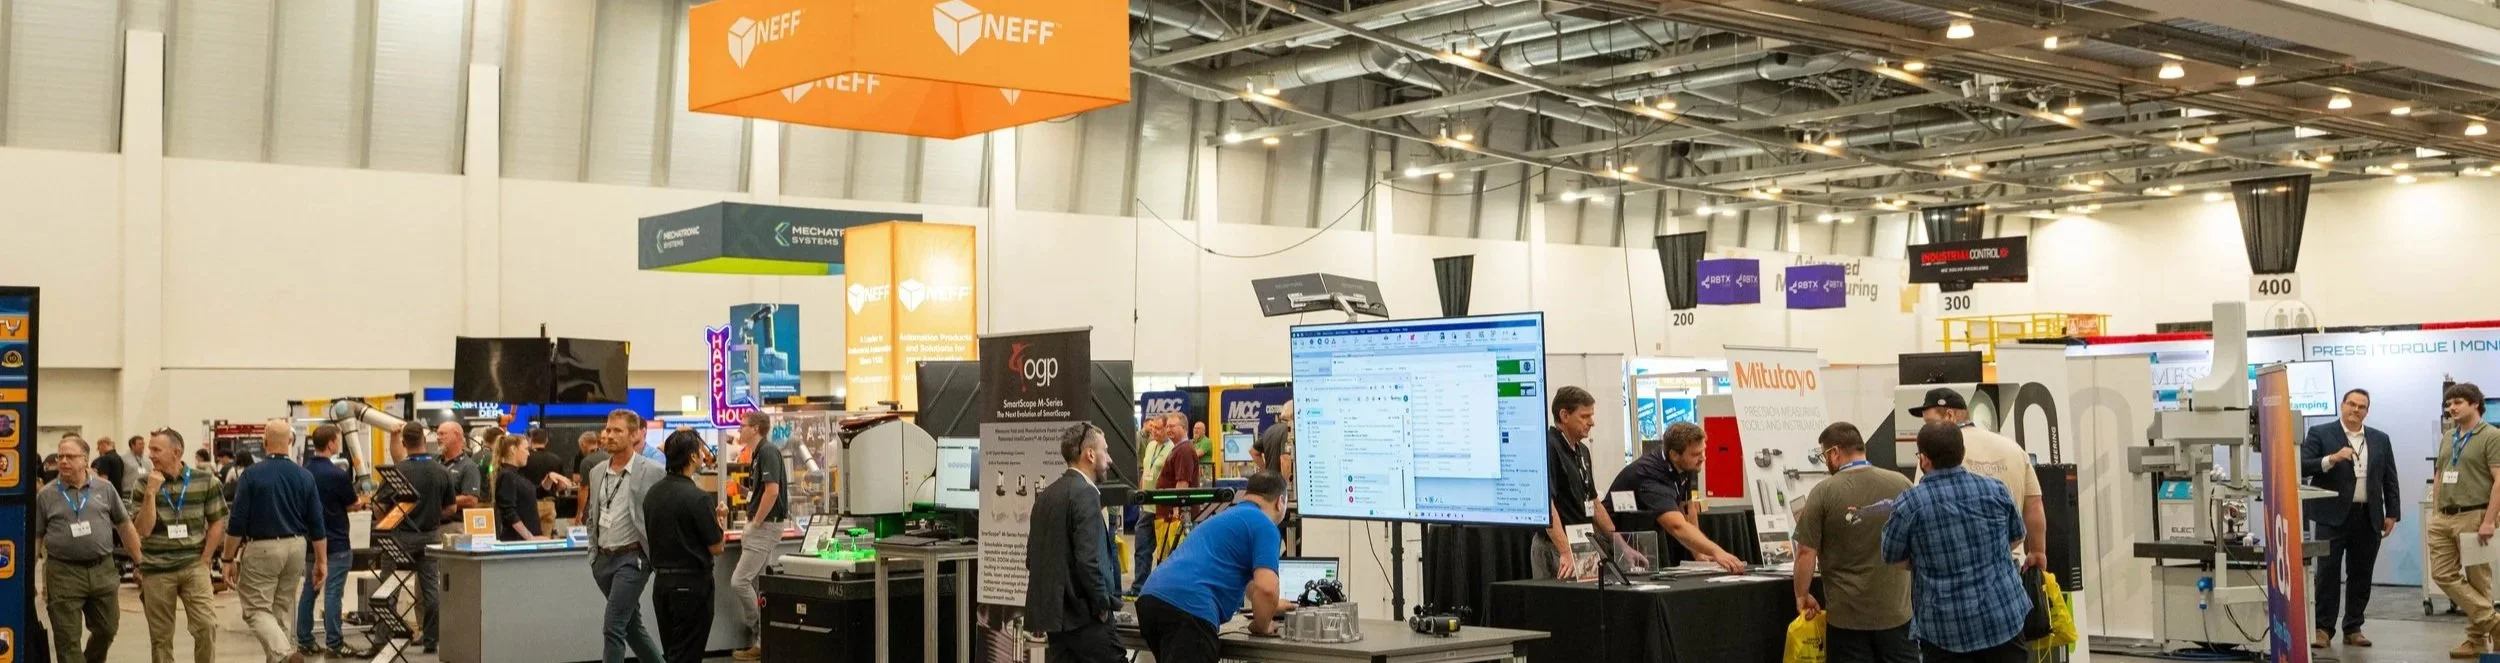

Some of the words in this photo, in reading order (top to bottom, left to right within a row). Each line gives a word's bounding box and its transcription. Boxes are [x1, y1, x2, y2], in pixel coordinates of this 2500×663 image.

[755, 9, 801, 45] NEFF
[983, 14, 1055, 45] NEFF
[791, 236, 839, 246] SYSTEMS
[2258, 278, 2292, 295] 400
[1944, 295, 1971, 311] 300
[1673, 312, 1695, 326] 200
[2312, 345, 2367, 356] PRESS
[2381, 340, 2447, 355] TORQUE
[712, 334, 723, 409] HAPPY
[1023, 357, 1058, 387] ogp
[1734, 361, 1816, 397] Mitutoyo
[1003, 399, 1036, 409] SmartScope
[1146, 398, 1182, 413] MCC
[1228, 401, 1261, 418] MCC
[829, 584, 844, 597] M45
